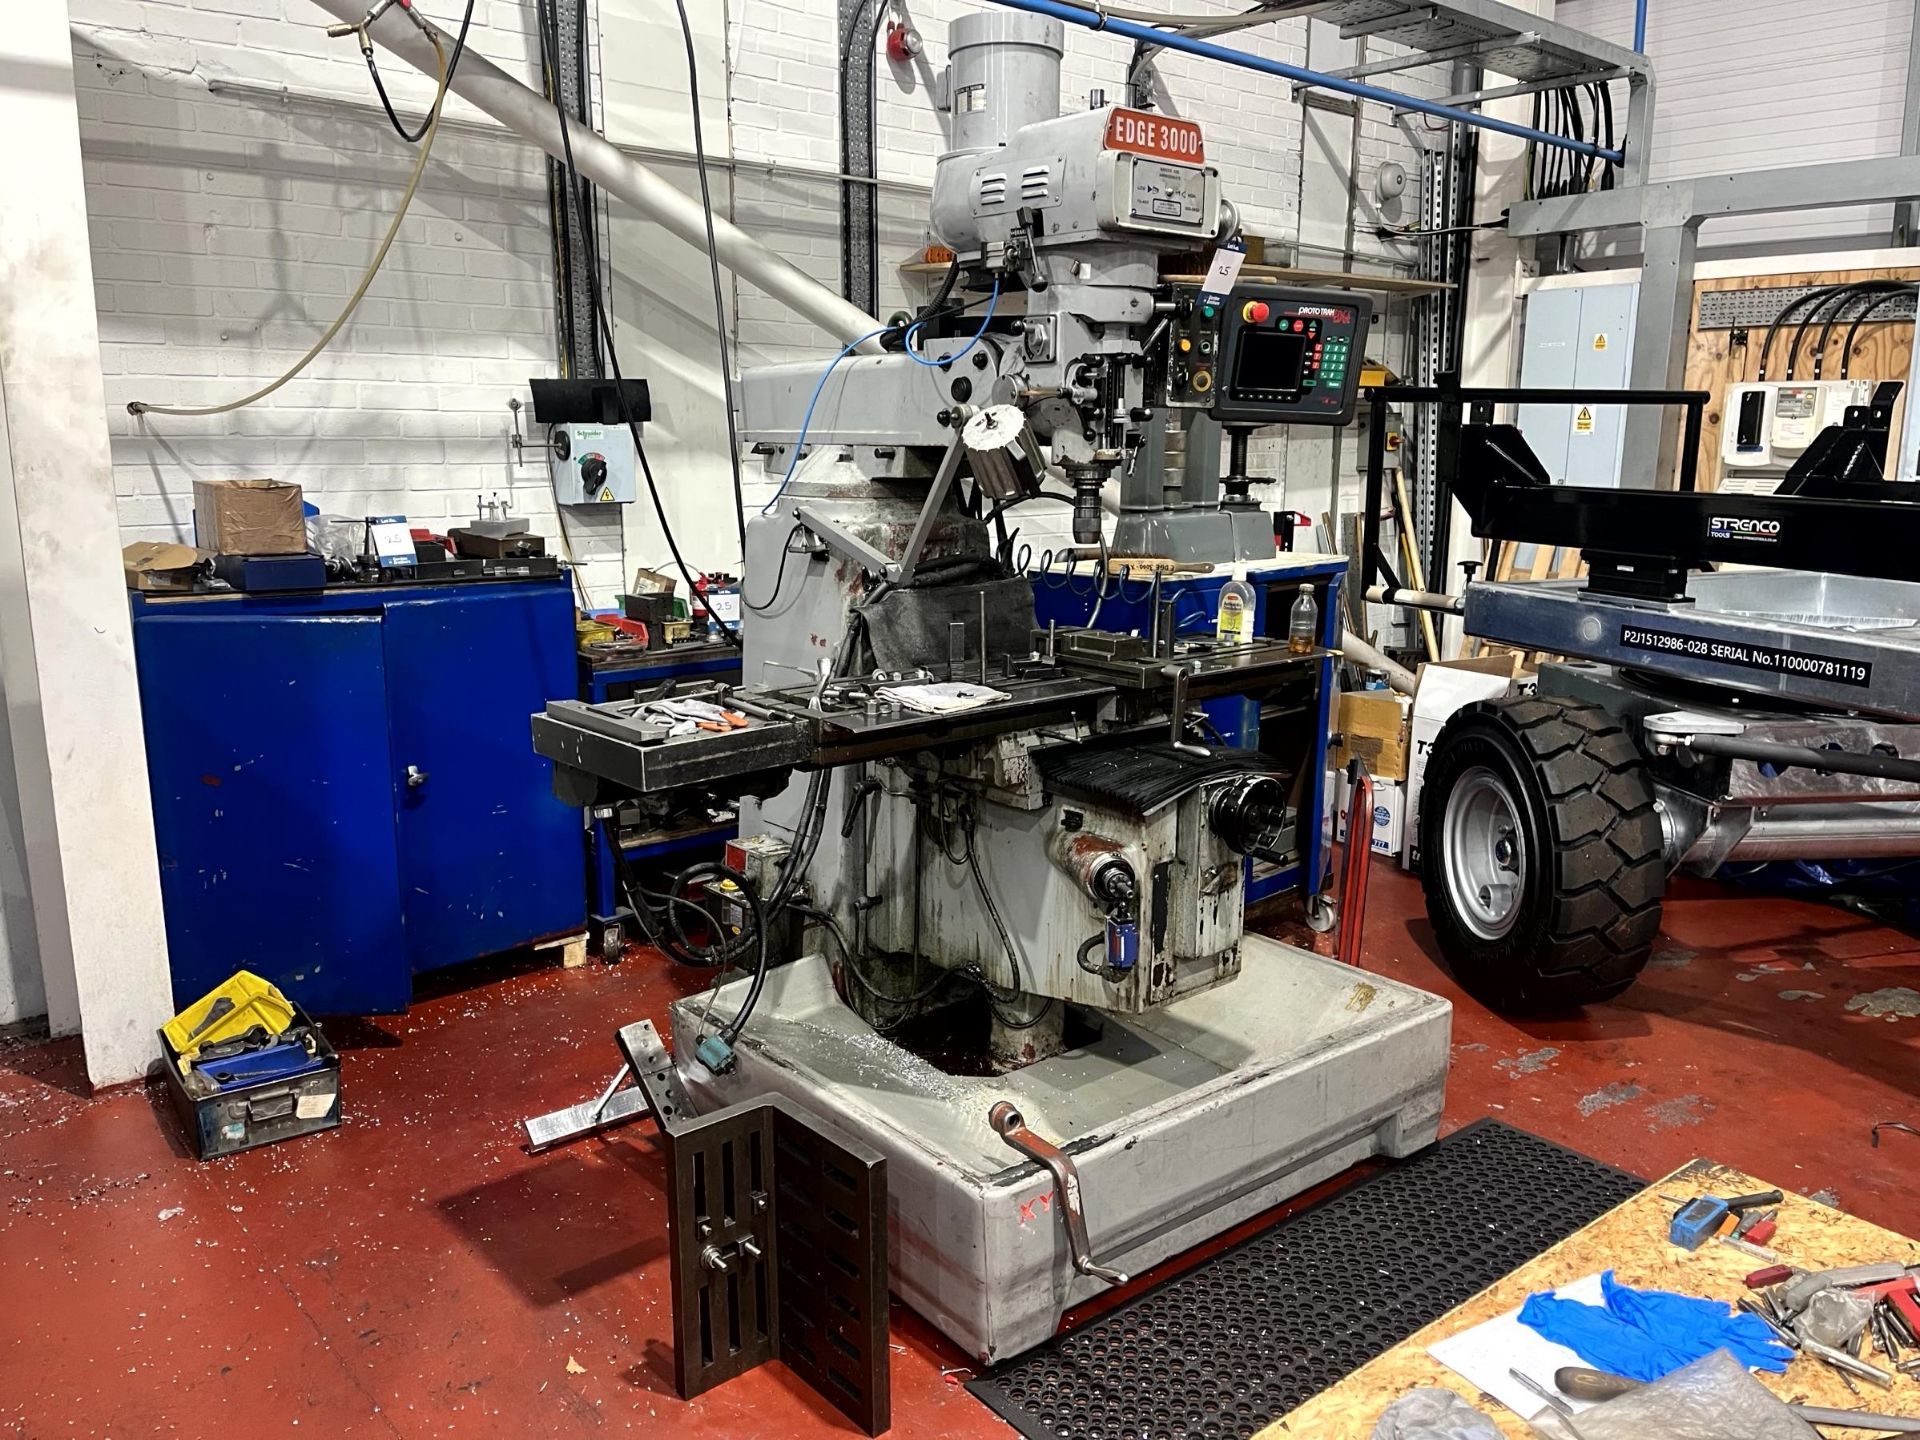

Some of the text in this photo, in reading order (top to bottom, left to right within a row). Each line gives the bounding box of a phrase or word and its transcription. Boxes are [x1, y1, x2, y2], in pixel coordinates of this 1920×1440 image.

[1115, 116, 1198, 156] EDGE 3000
[1218, 265, 1232, 276] 25
[1711, 517, 1780, 533] STRENCO
[384, 533, 402, 544] 25
[715, 601, 732, 611] 25
[1624, 631, 1866, 680] P2J1512986-028 SERIAL No.110000781119
